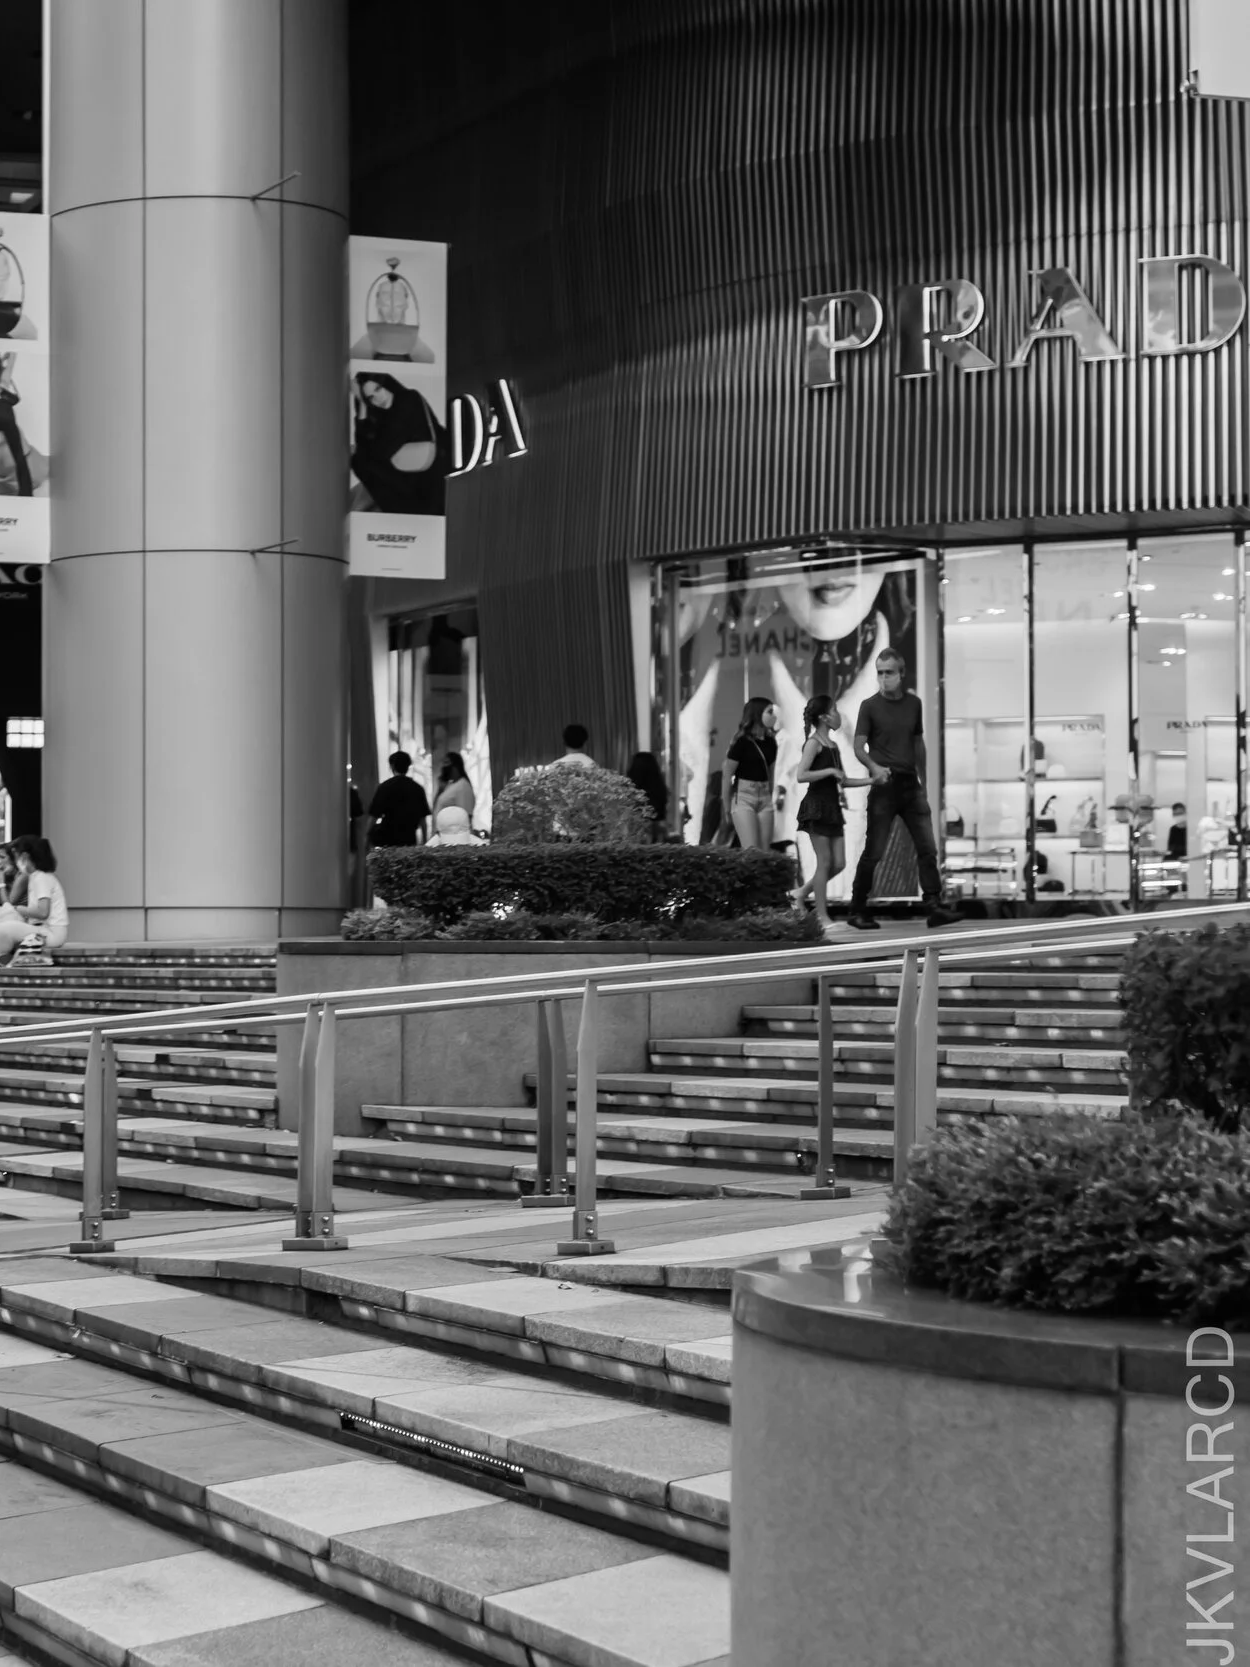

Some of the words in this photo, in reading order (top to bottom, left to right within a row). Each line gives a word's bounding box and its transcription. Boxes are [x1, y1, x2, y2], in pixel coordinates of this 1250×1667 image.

[800, 253, 1247, 388] PRAD
[366, 533, 417, 543] BURBERRY
[1062, 722, 1103, 732] PRADA
[1166, 720, 1208, 731] PRADA
